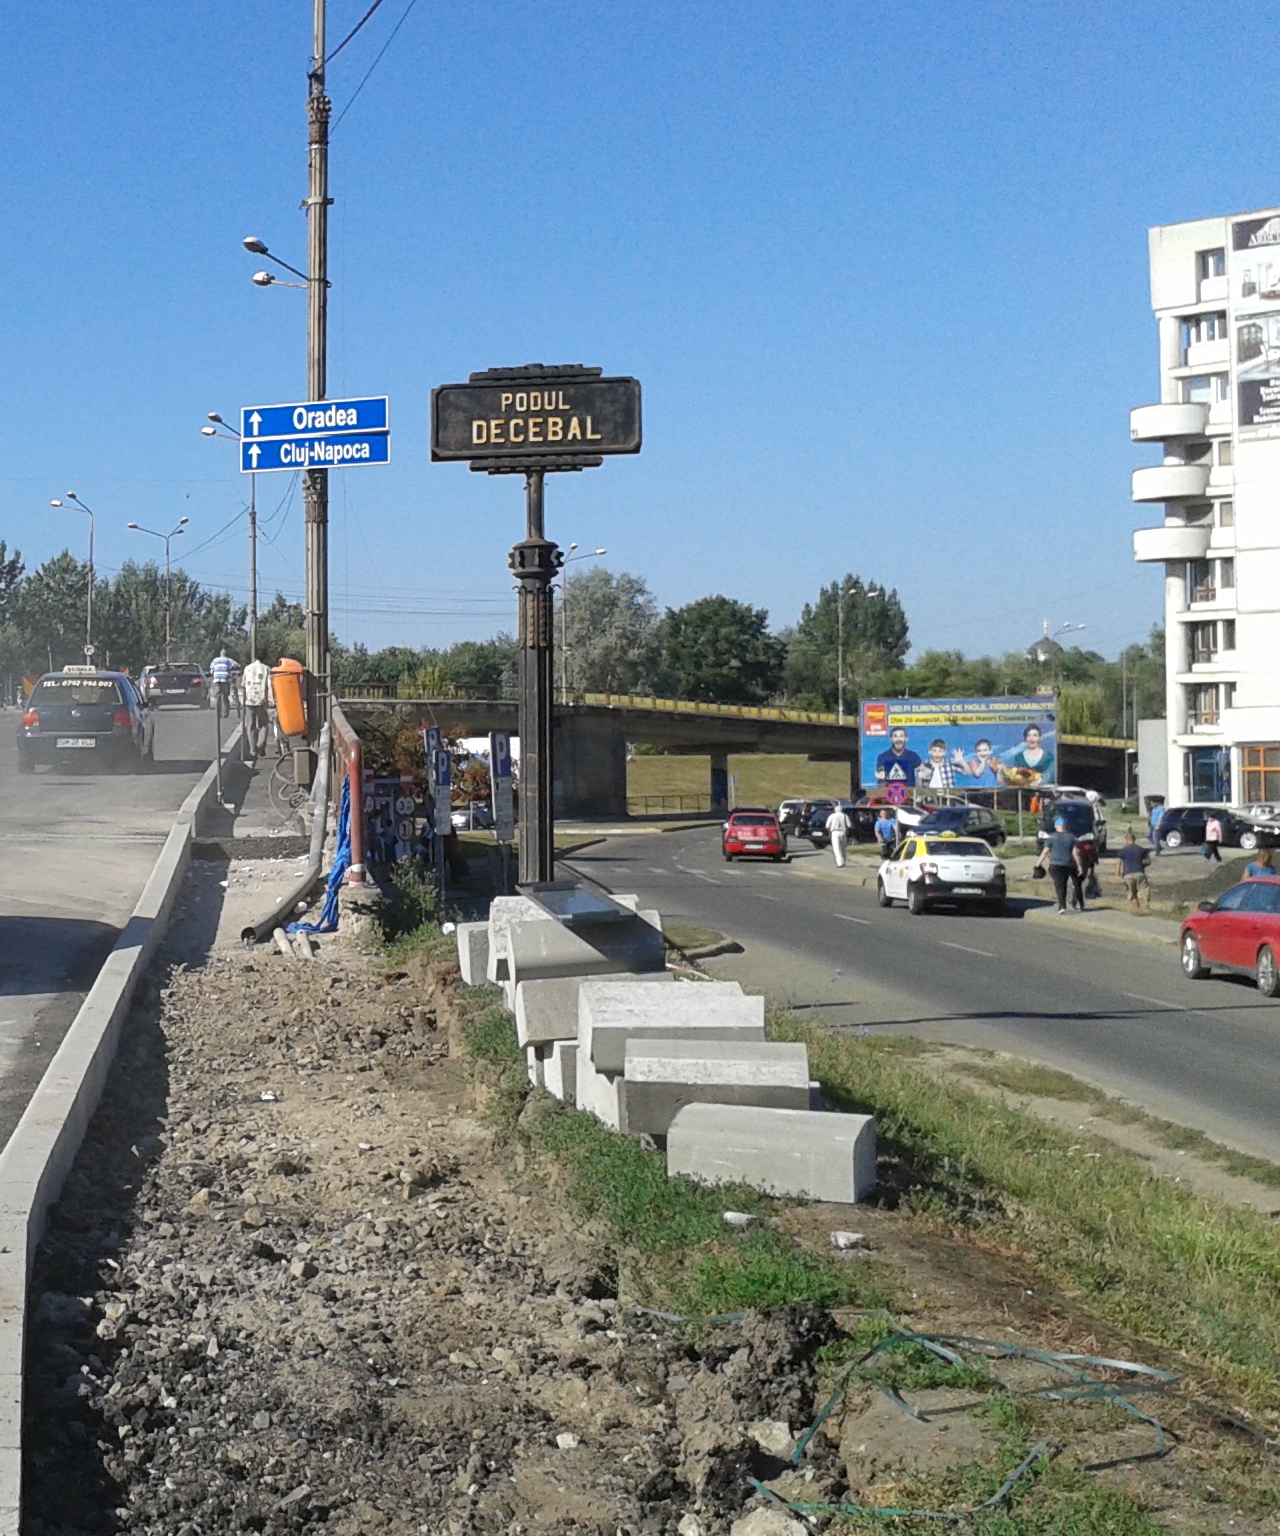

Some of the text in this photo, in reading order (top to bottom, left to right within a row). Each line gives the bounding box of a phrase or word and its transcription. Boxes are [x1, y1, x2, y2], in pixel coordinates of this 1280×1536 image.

[501, 391, 571, 412] PODUL
[292, 405, 357, 429] Oradea
[472, 416, 601, 443] DECEBAL
[280, 441, 370, 467] Cluj-Napoca
